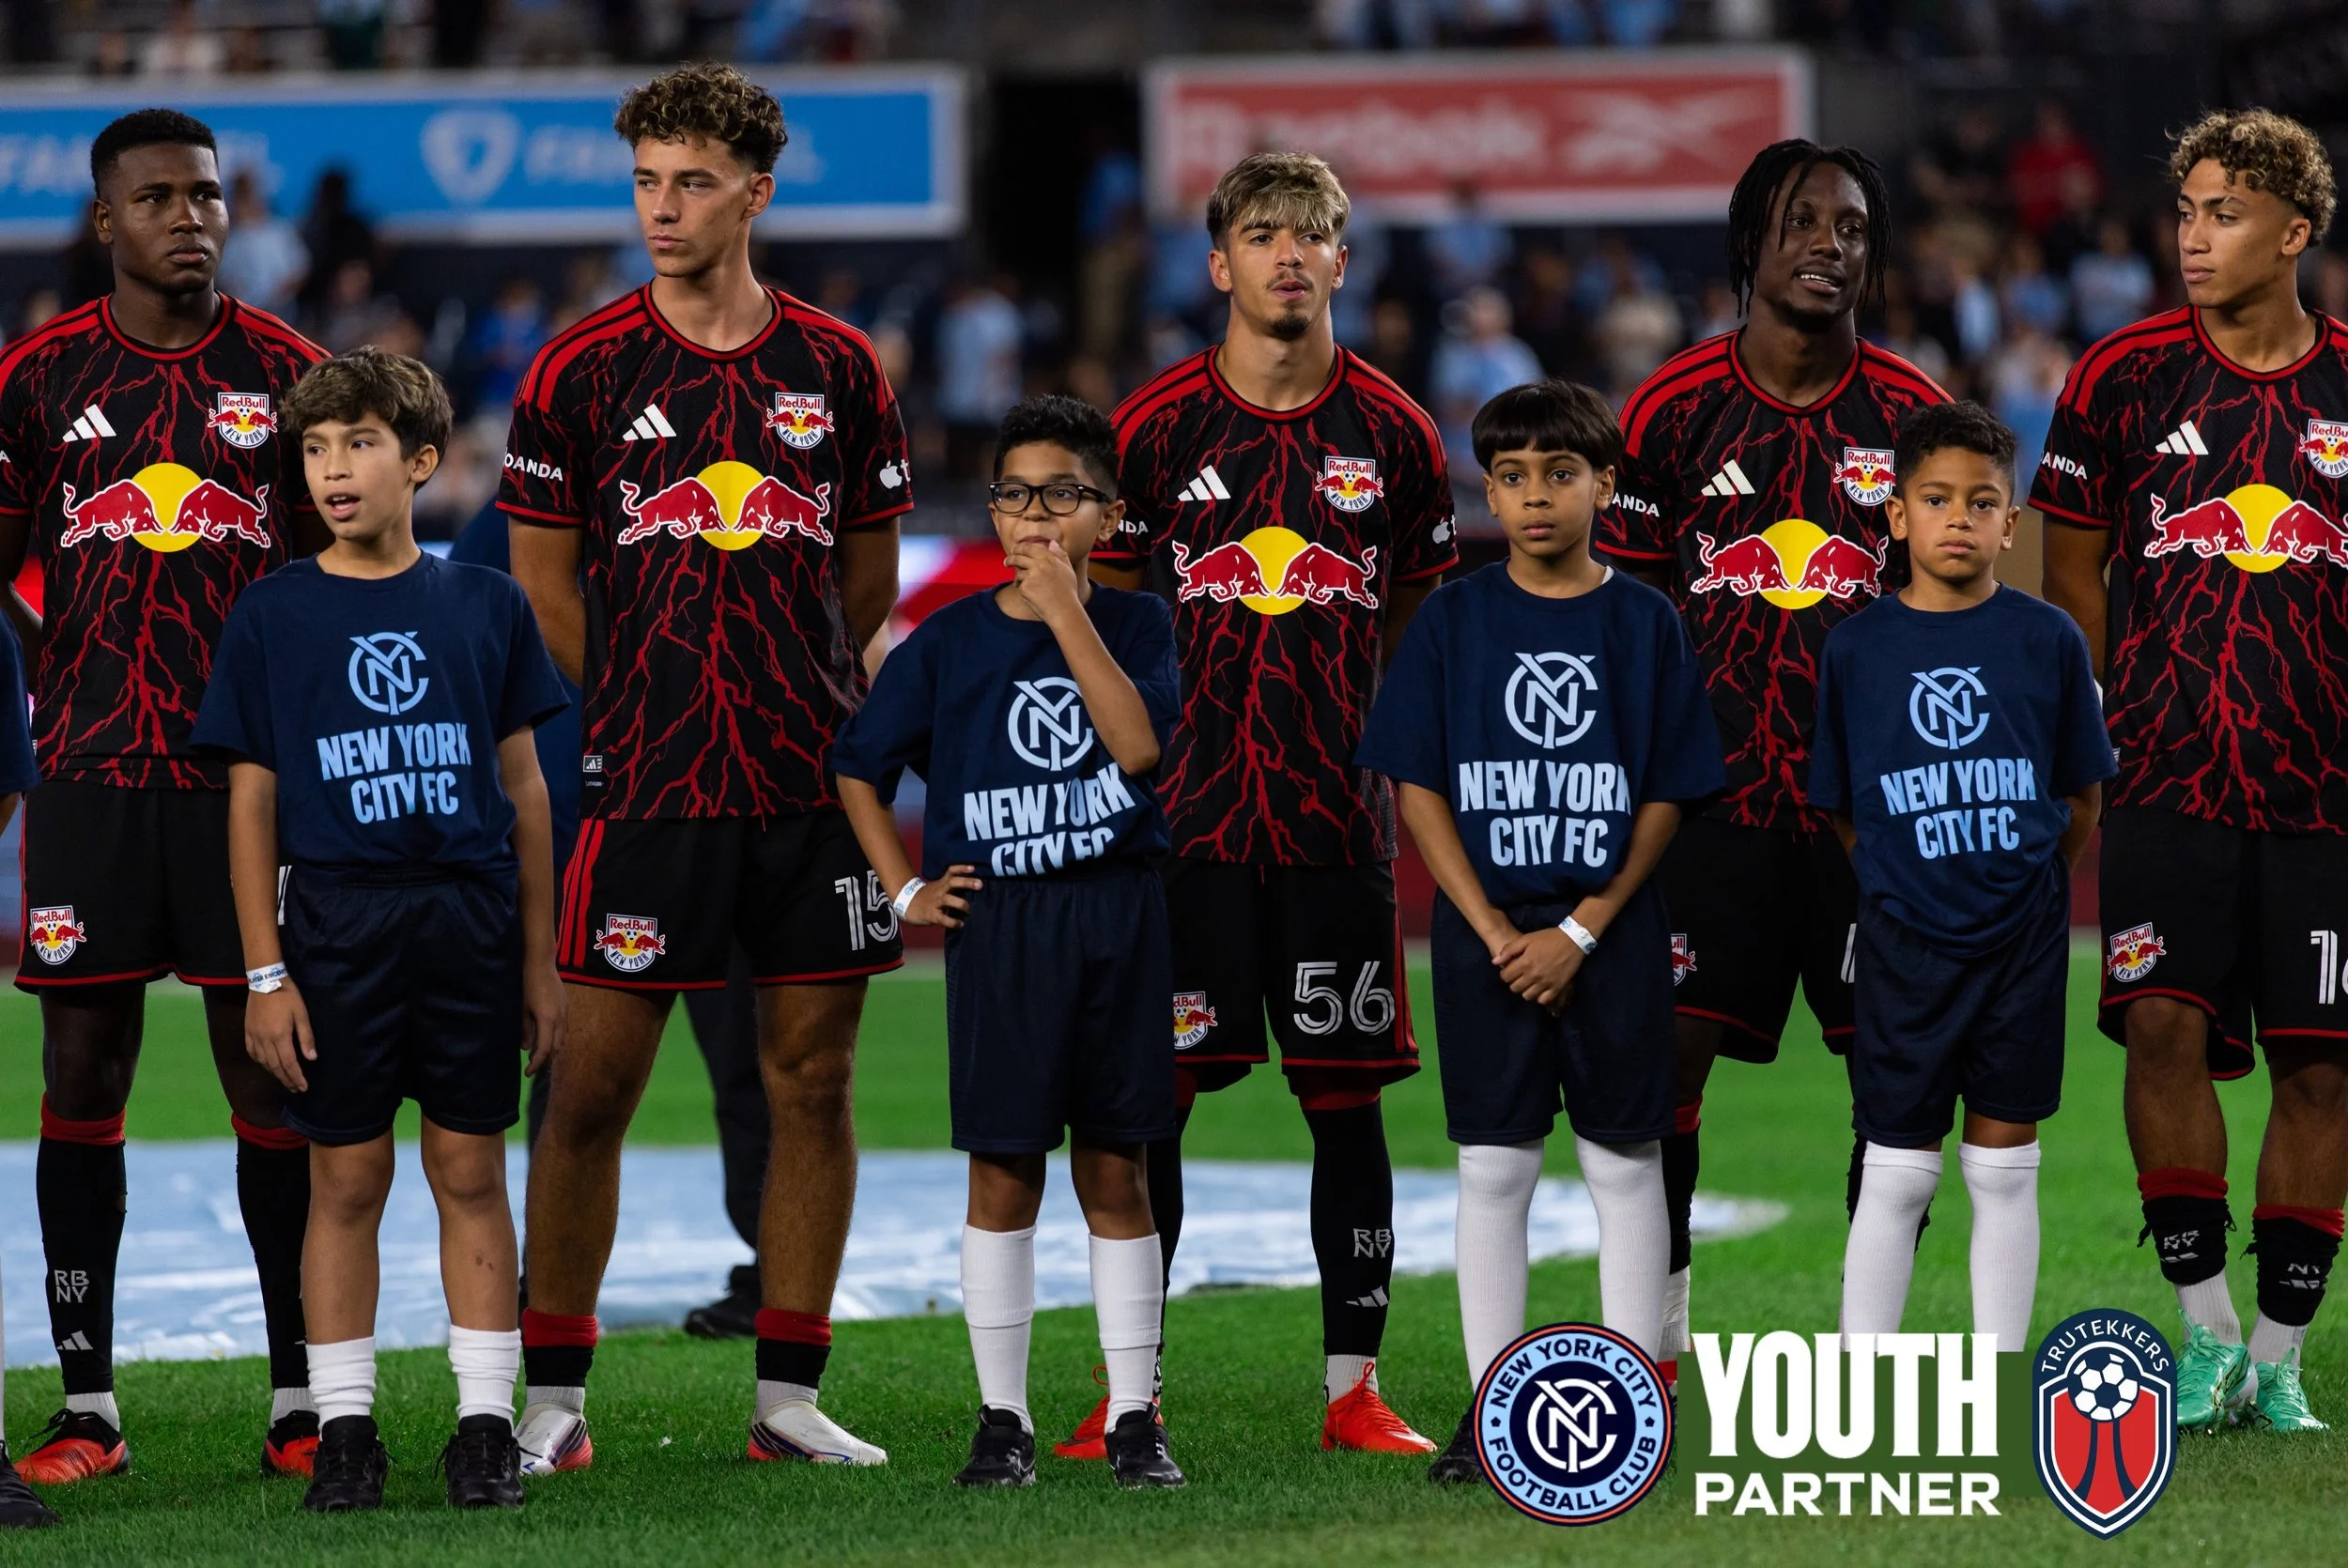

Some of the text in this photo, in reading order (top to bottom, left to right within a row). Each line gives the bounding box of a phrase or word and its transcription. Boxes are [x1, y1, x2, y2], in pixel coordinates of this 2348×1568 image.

[225, 427, 264, 444] NEW YORK
[781, 428, 819, 445] NEW YORK
[2334, 426, 2348, 438] Bu
[504, 453, 564, 482] OANDA
[2041, 451, 2088, 480] ANDA
[2312, 456, 2327, 470] NEW
[1330, 492, 1368, 509] NEW YORK
[1611, 491, 1661, 517] ANDA
[1849, 484, 1887, 502] NEW YORK
[317, 722, 471, 781] NEW YORK
[350, 771, 458, 824] CITY FC
[1458, 759, 1631, 816] NEW YORK
[1879, 758, 2037, 816] NEW YORK
[964, 761, 1136, 841] NEW YORK
[1489, 814, 1609, 868] CITY FC
[1914, 806, 2020, 860] CITY FC
[991, 831, 1067, 877] CITY
[834, 869, 899, 951] 15
[39, 943, 71, 961] NEW YORK
[610, 950, 650, 969] NEW YORK
[2310, 930, 2348, 1004] 1
[1293, 961, 1396, 1036] 56
[1352, 1227, 1392, 1243] RB
[1353, 1241, 1391, 1258] NY
[54, 1269, 90, 1286] RB
[56, 1285, 88, 1303] NY
